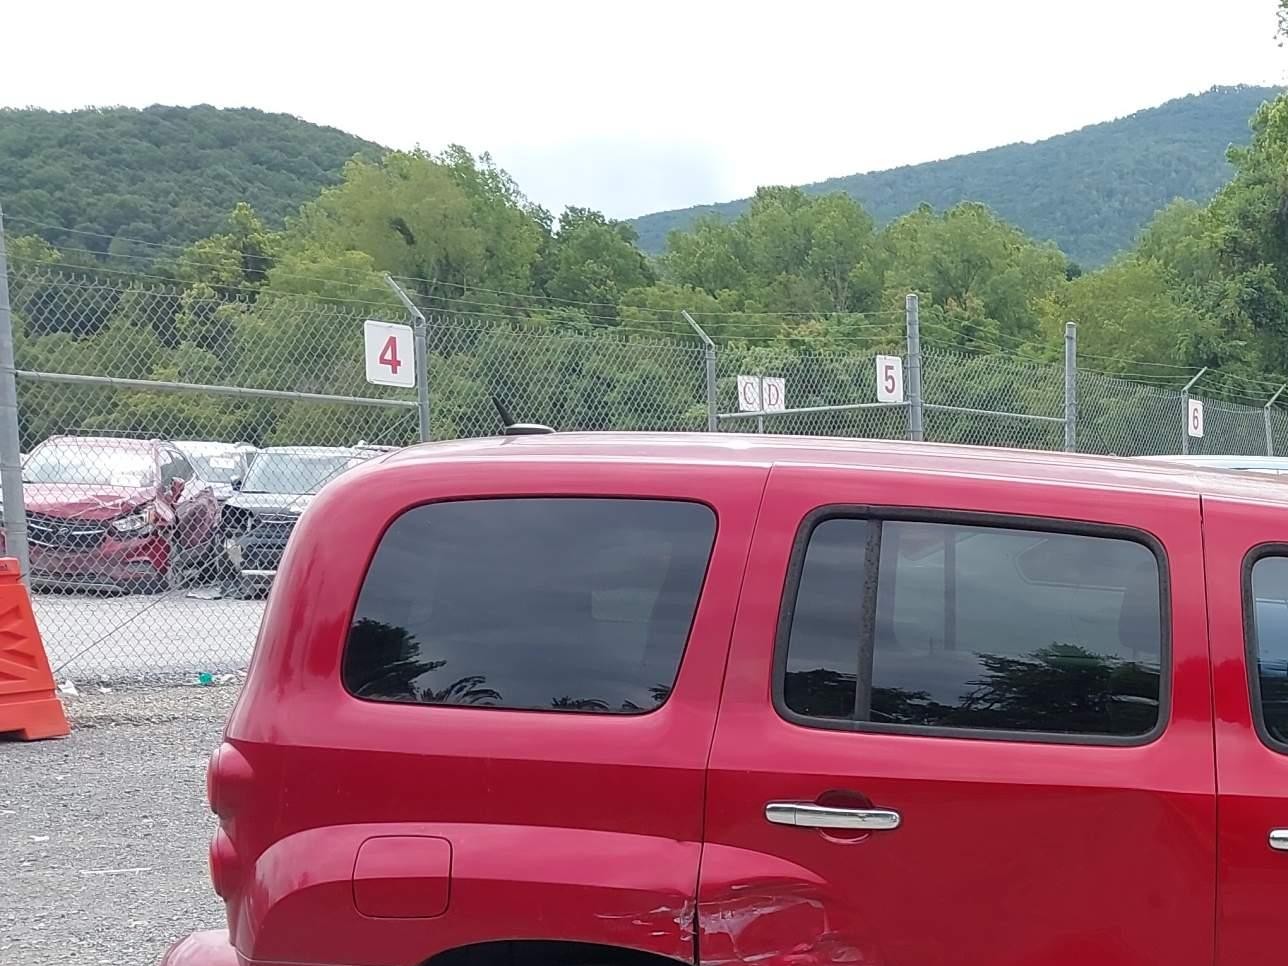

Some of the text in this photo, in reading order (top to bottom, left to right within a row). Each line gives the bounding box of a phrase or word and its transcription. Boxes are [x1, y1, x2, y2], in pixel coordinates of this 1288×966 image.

[379, 335, 402, 375] 4
[884, 365, 896, 394] 5
[743, 381, 755, 405] C
[767, 383, 780, 406] D
[1192, 407, 1199, 430] 6
